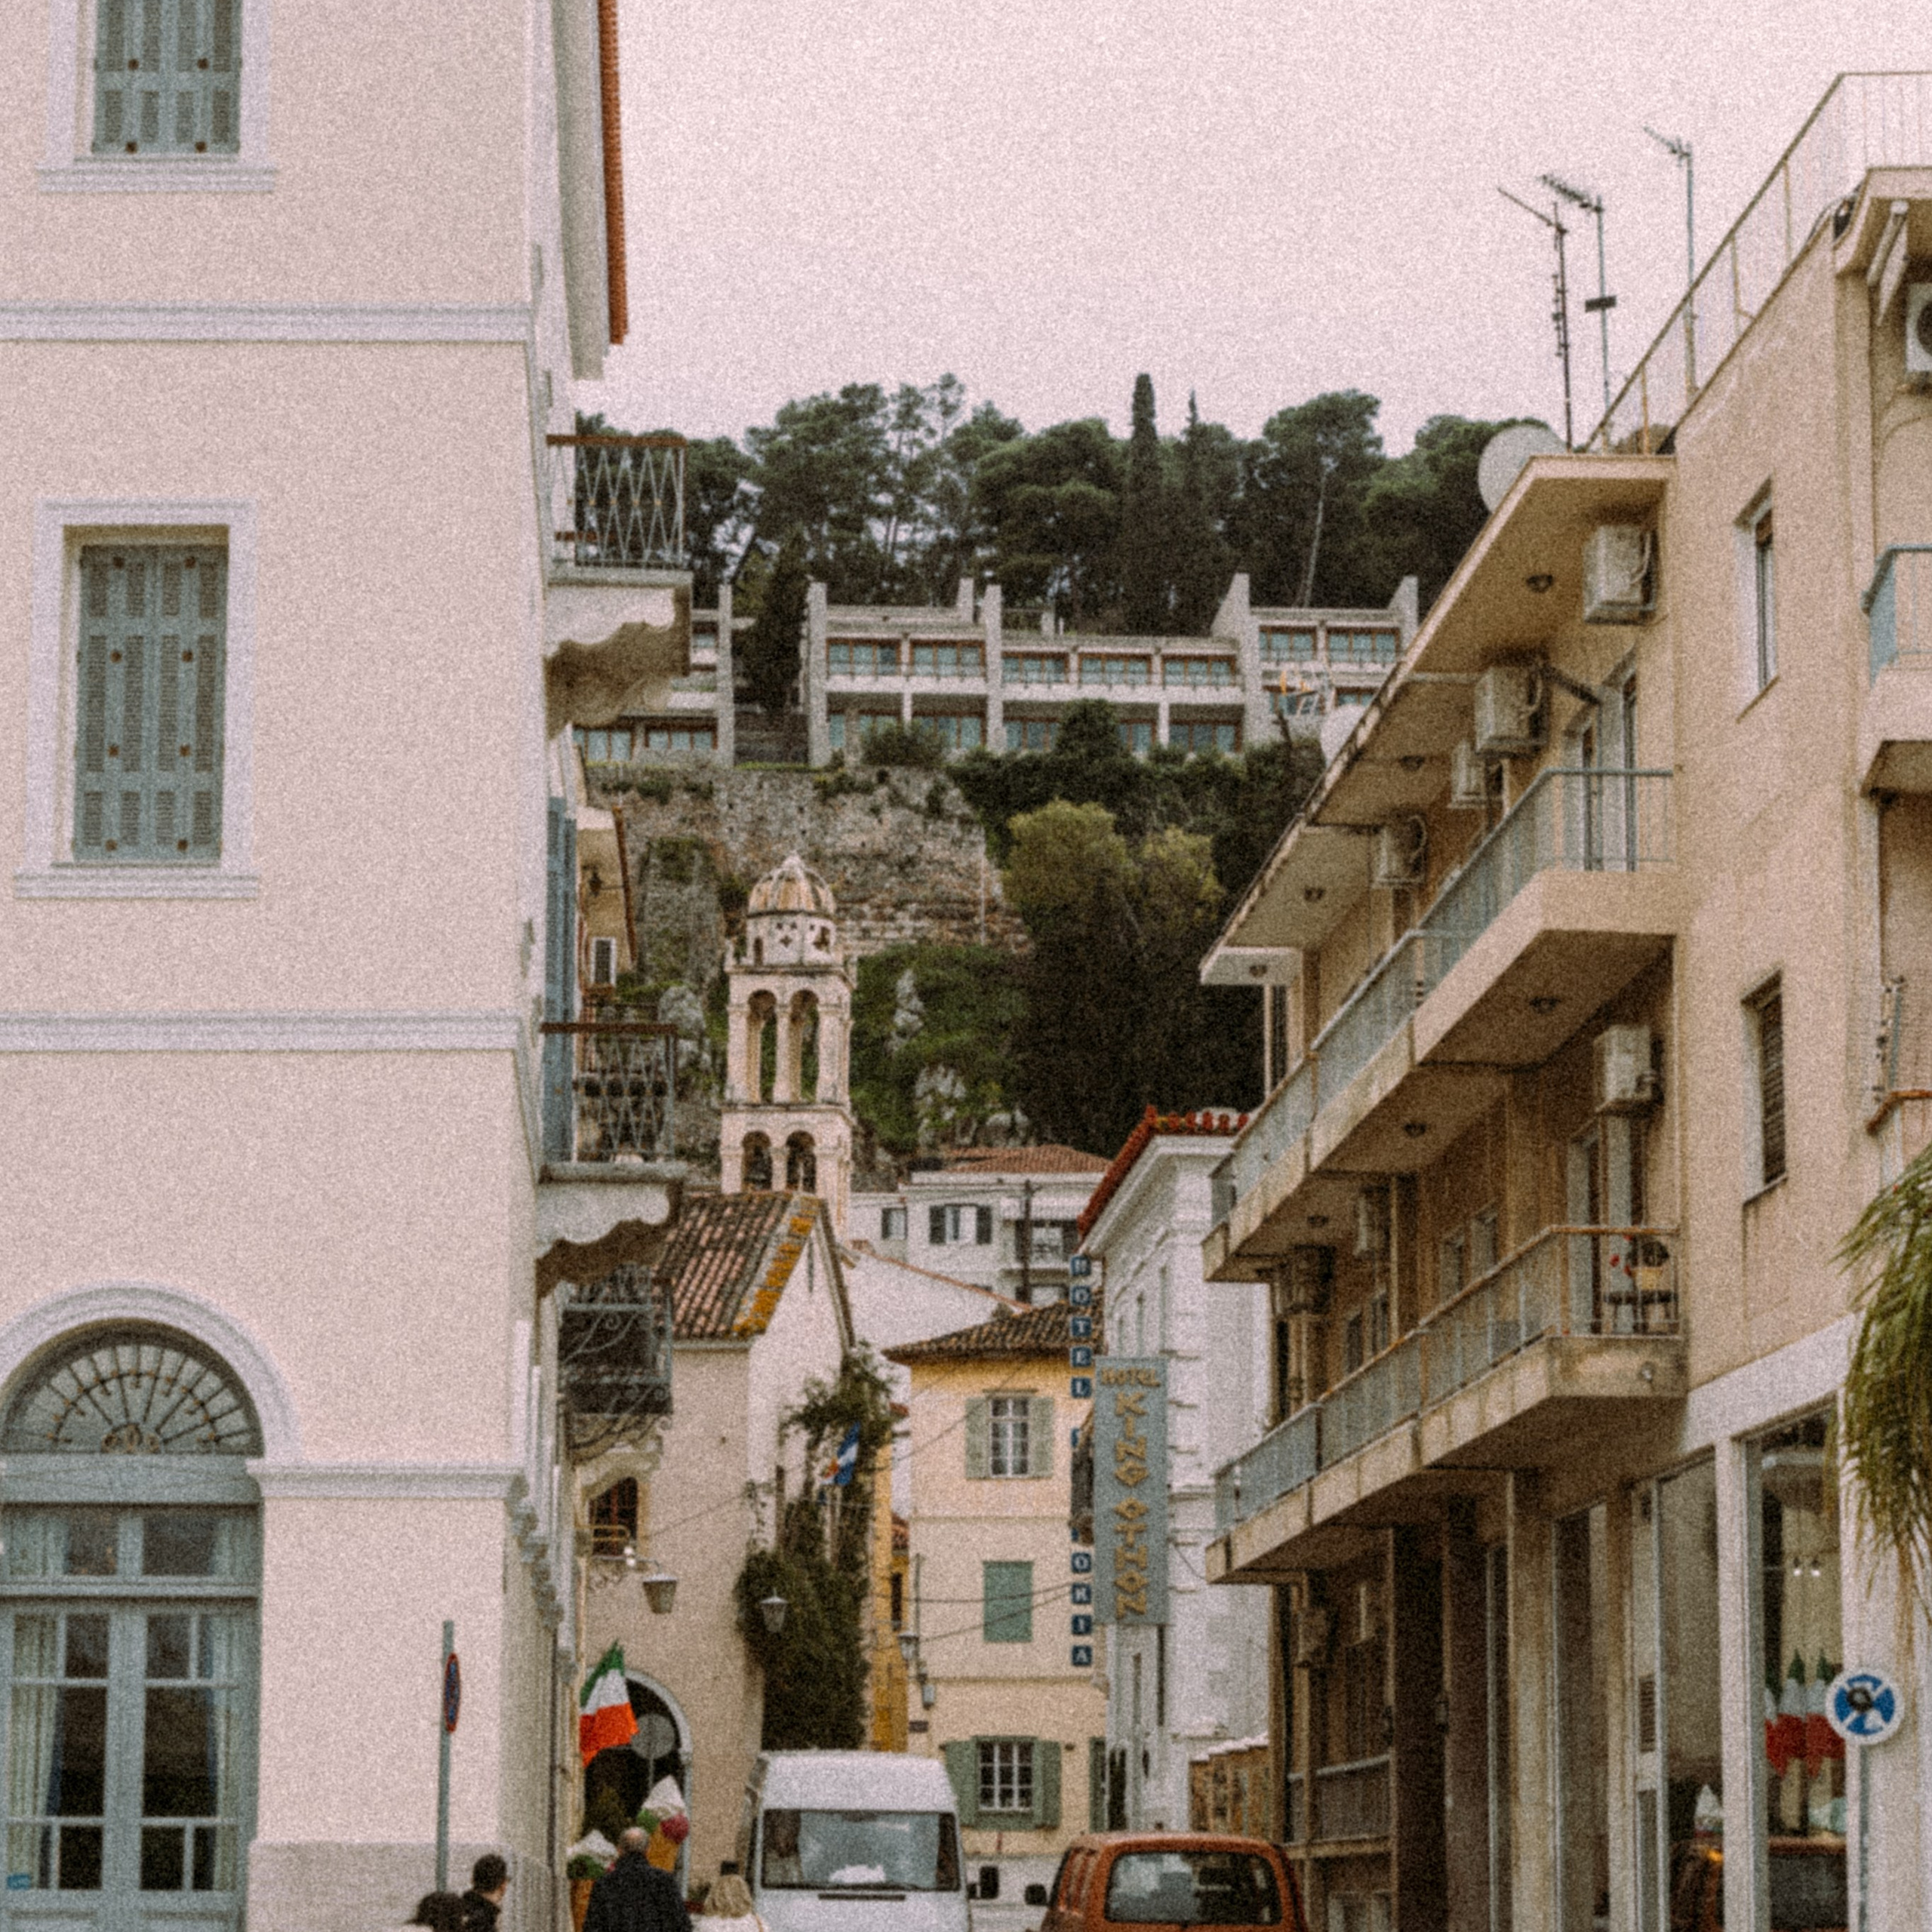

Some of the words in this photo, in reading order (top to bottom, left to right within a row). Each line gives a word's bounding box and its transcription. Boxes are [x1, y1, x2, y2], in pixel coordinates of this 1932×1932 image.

[1072, 1260, 1090, 1395] HOTEL
[1100, 1367, 1161, 1387] HOTEL
[1115, 1392, 1149, 1487] KING
[1114, 1497, 1149, 1619] OTHON
